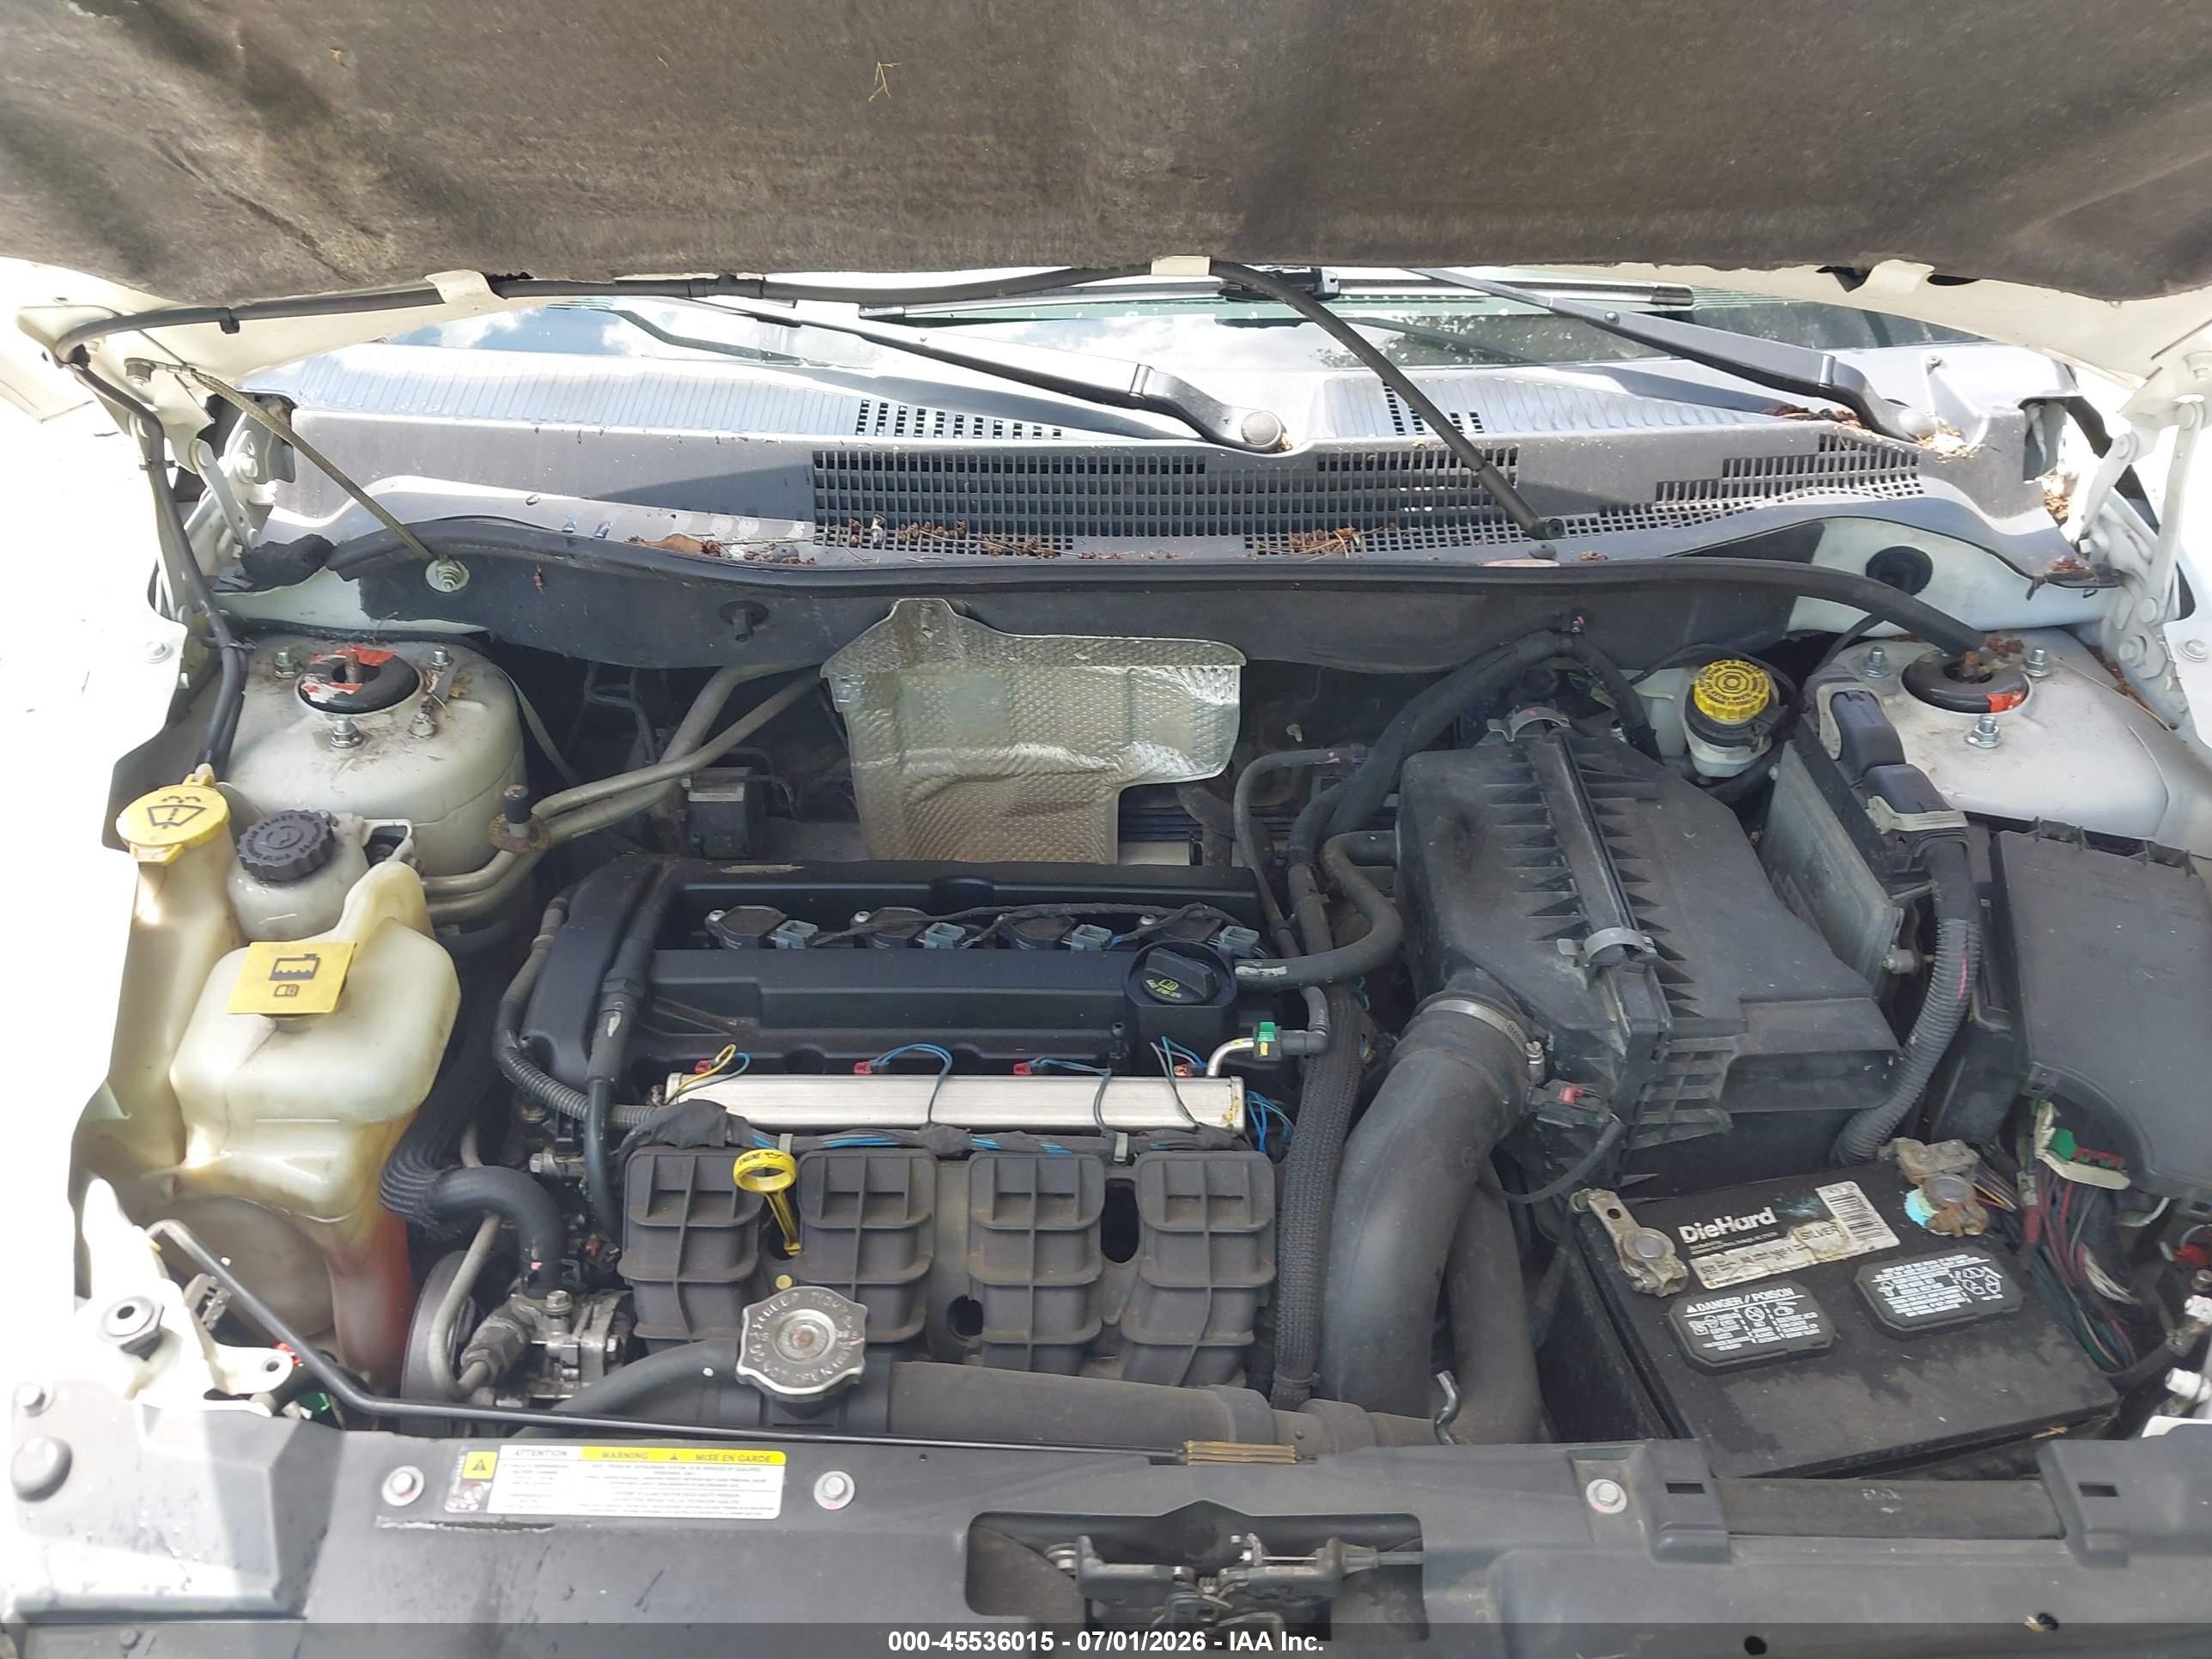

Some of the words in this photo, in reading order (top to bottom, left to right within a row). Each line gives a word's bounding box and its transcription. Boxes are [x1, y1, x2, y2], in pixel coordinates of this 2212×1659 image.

[1677, 1206, 1778, 1244] DieHard
[1800, 1225, 1844, 1241] SILVER
[1696, 1297, 1744, 1313] DANGER
[1750, 1287, 1796, 1302] POISON
[515, 1449, 568, 1457] ATTENTION
[602, 1451, 648, 1460] WARNING
[696, 1453, 720, 1462] MISE
[722, 1454, 735, 1462] EN
[737, 1454, 771, 1463] GARDE
